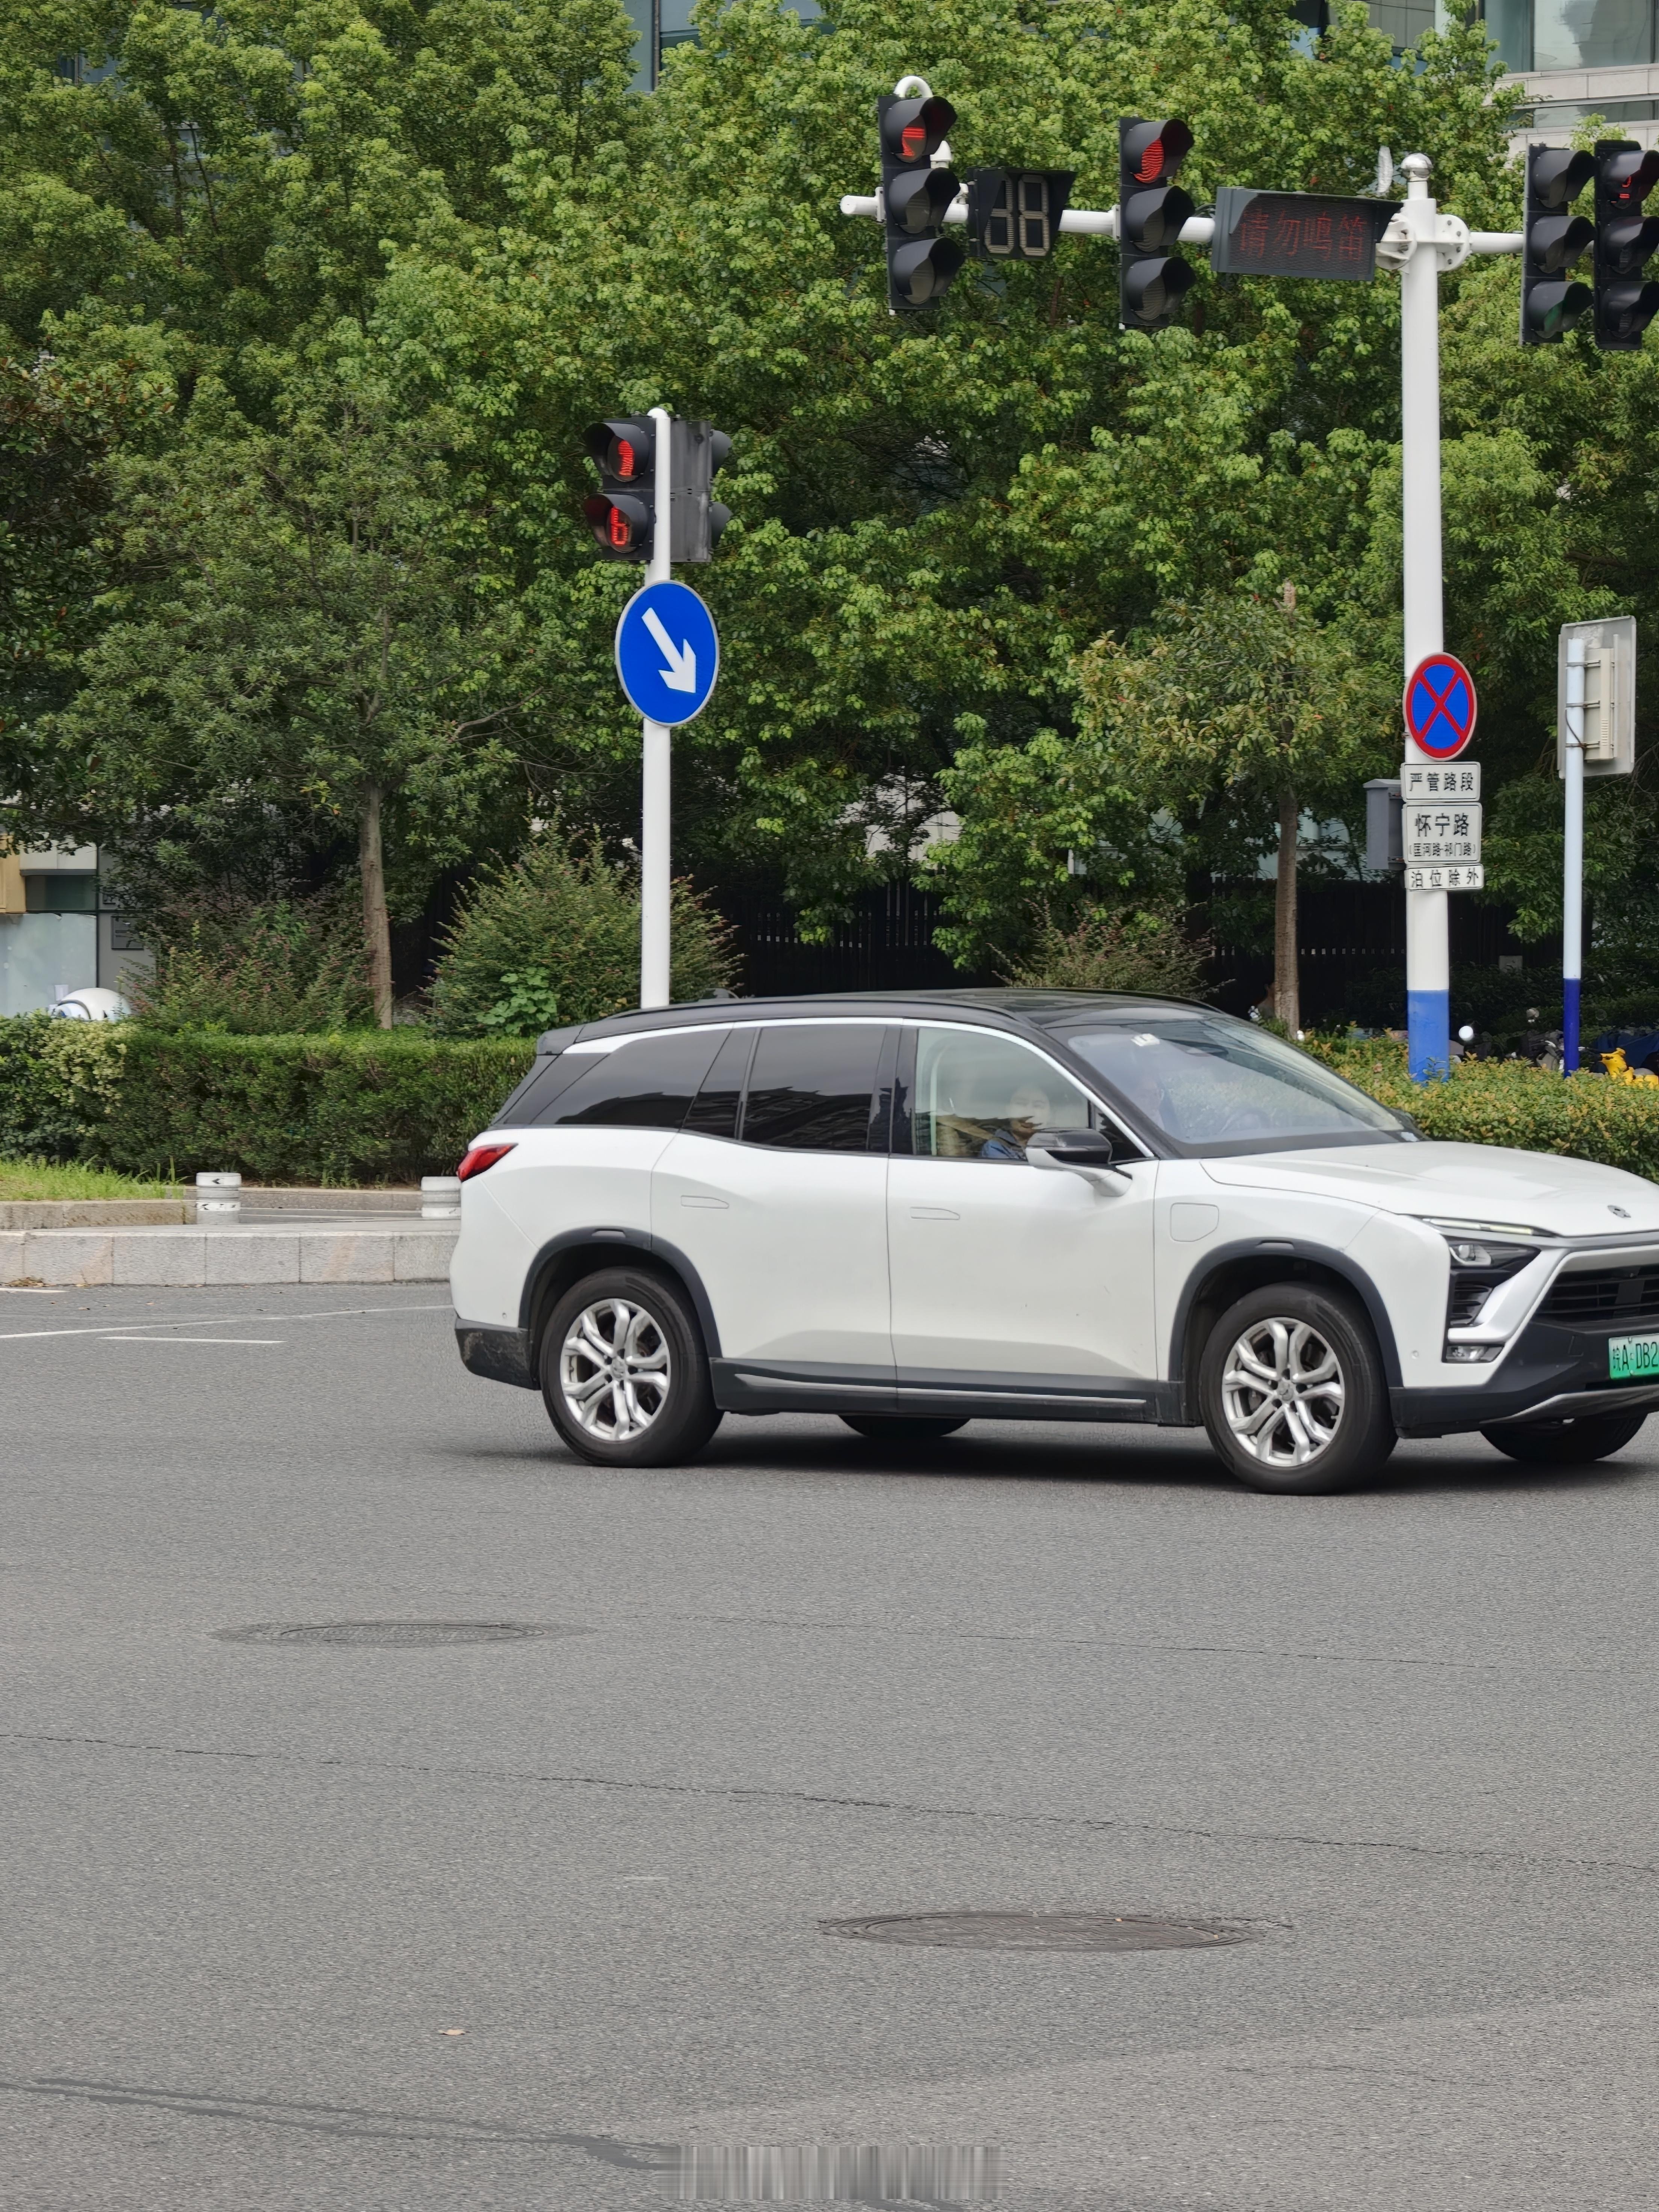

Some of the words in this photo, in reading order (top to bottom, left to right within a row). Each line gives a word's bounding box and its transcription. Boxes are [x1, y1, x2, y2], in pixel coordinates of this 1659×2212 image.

[1240, 207, 1367, 260] 请勿鸣笛
[1409, 772, 1474, 792] 严管路段
[1415, 812, 1470, 837] 怀宁路
[1411, 867, 1479, 888] 泊位除外
[1613, 1342, 1659, 1371] 皖ADB2
